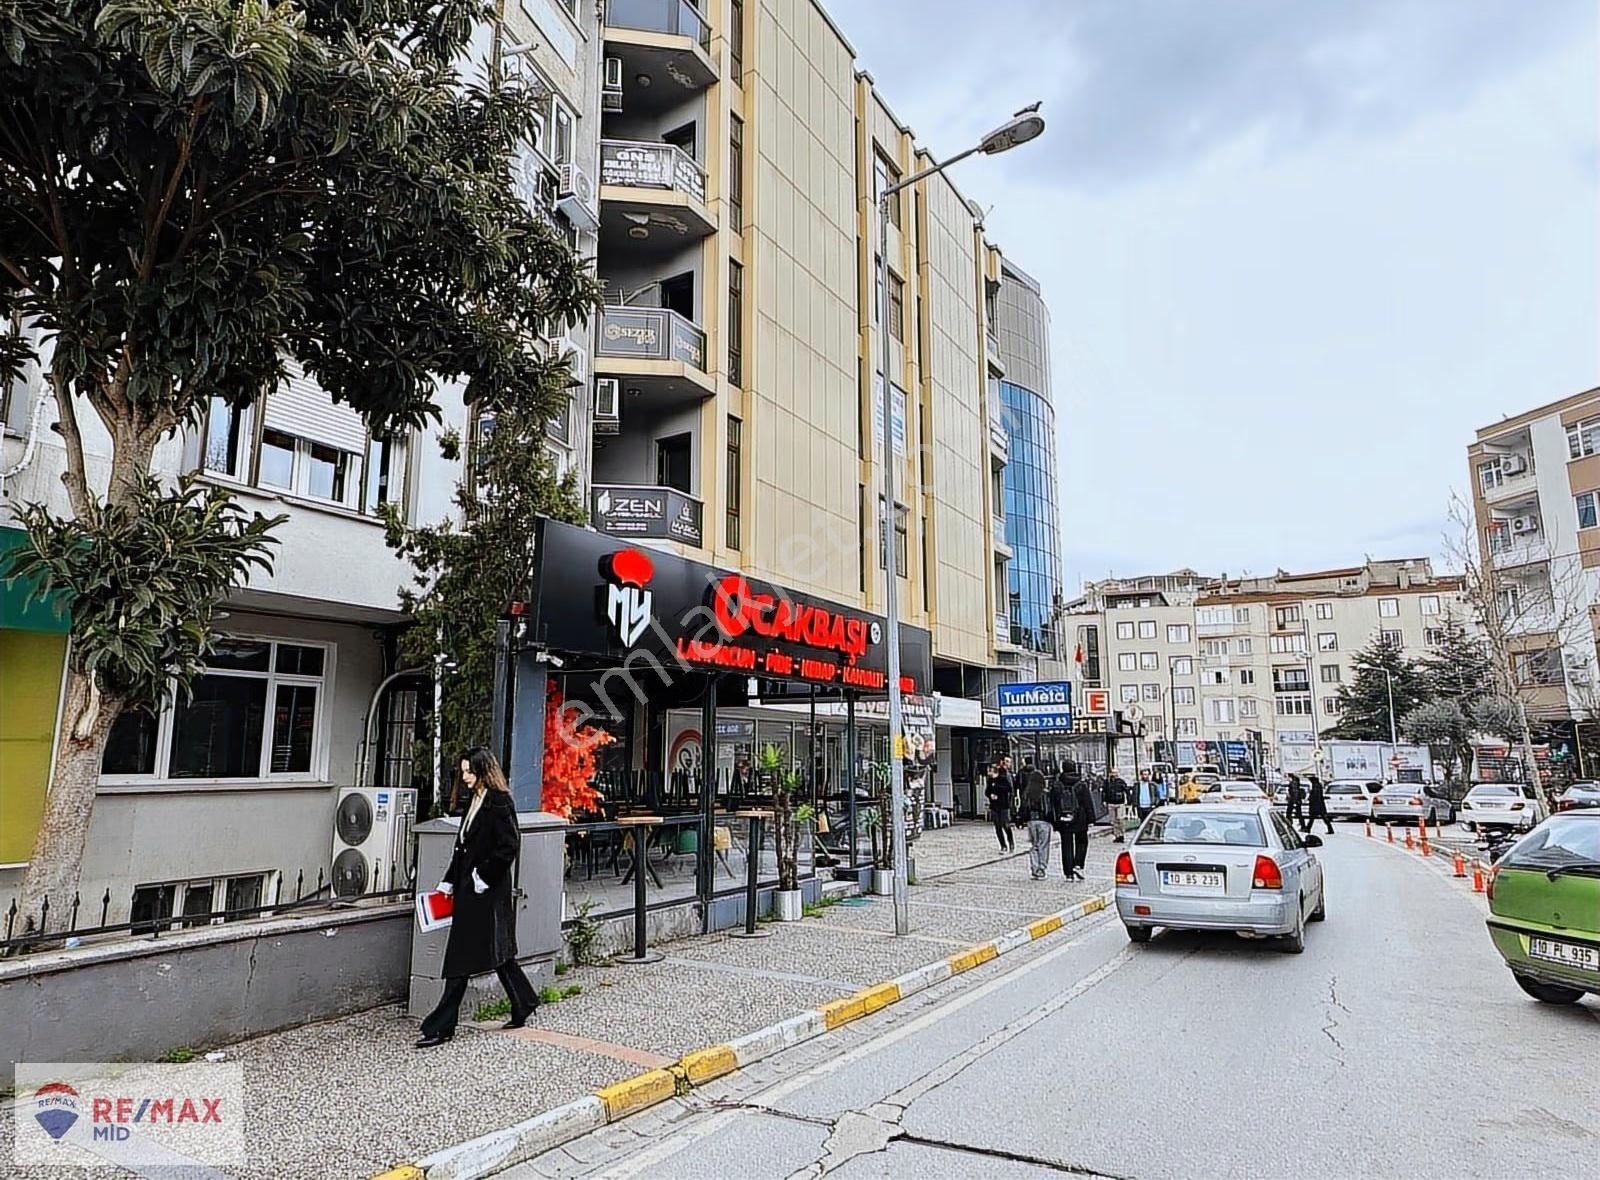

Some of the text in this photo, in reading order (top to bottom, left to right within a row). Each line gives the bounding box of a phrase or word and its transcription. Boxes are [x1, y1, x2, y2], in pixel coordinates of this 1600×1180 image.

[615, 498, 661, 512] ZEN
[608, 583, 652, 648] MY
[714, 574, 868, 665] OCAKBAŞI
[1004, 690, 1065, 704] TurMeta
[1090, 694, 1106, 711] E
[1170, 874, 1180, 883] 10
[1537, 941, 1592, 962] 10 PL 935
